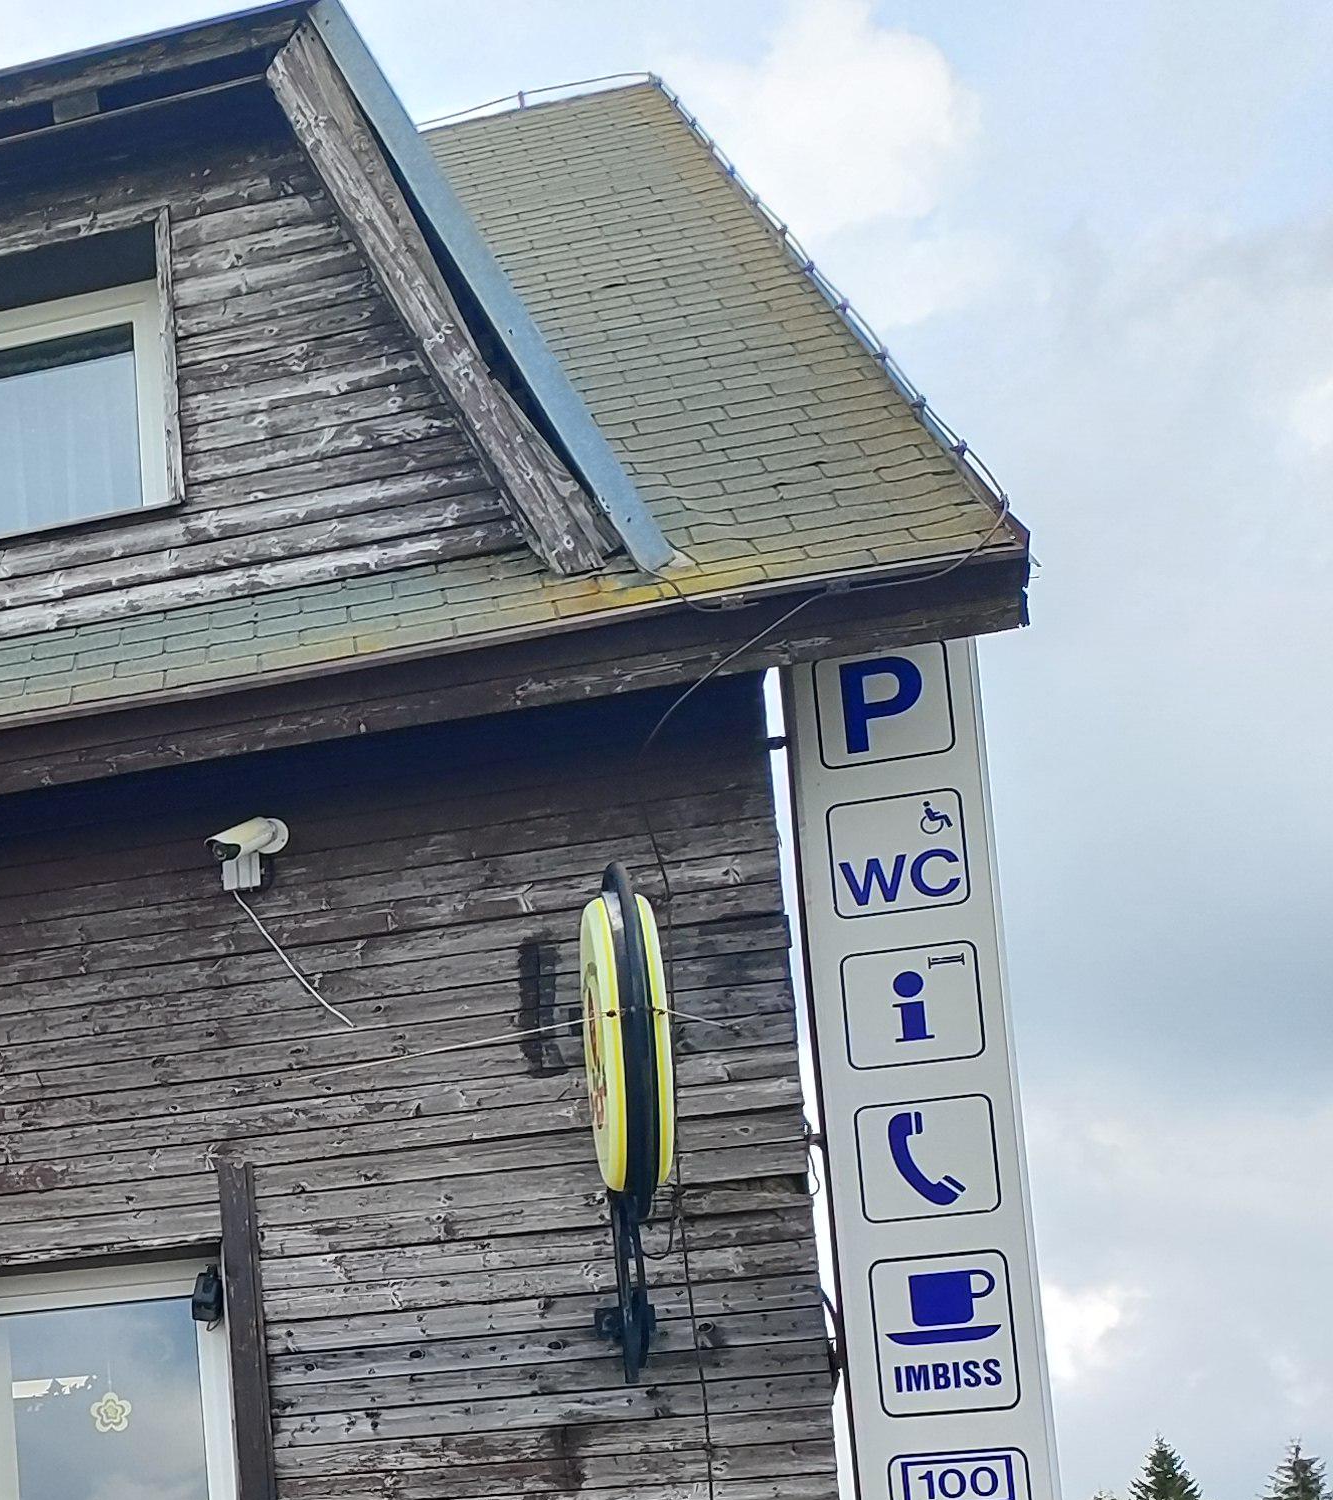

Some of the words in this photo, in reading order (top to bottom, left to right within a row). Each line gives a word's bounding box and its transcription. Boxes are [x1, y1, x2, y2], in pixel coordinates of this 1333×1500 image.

[839, 655, 923, 755] P
[839, 848, 962, 907] WC
[893, 1358, 1003, 1394] IMBISS
[918, 1466, 999, 1500] 100
